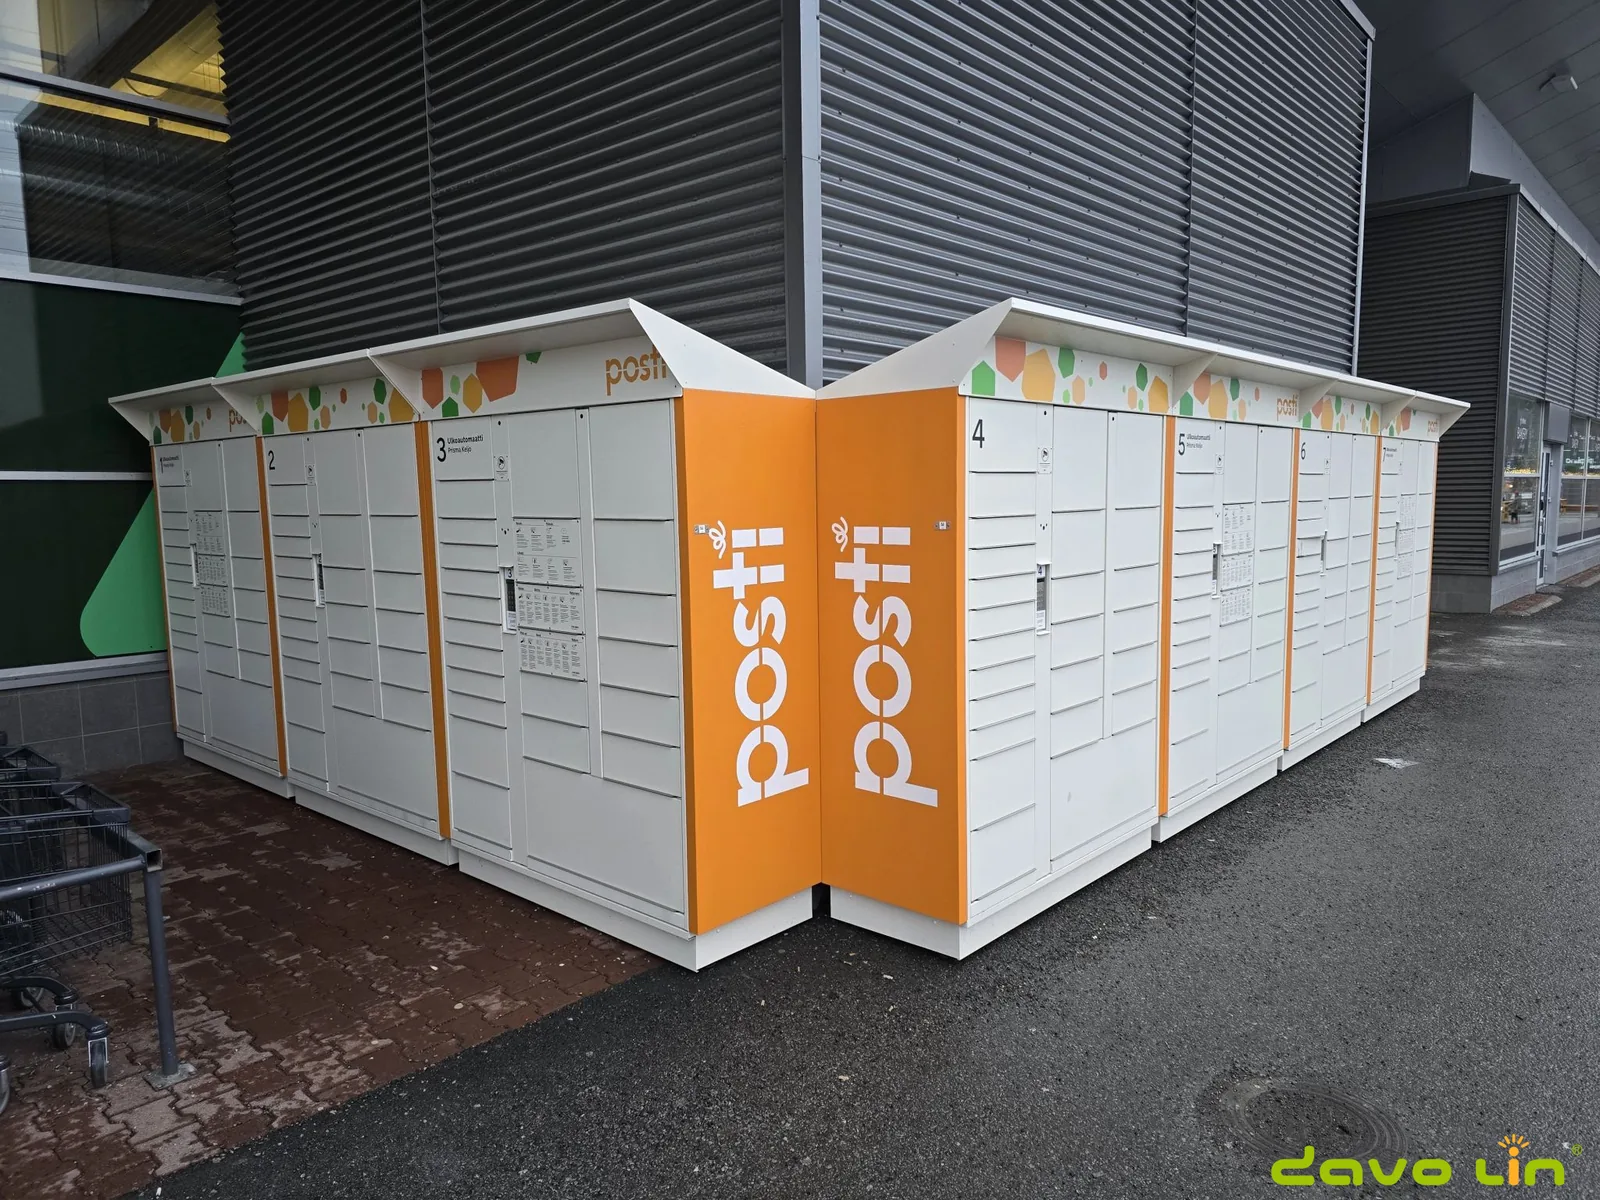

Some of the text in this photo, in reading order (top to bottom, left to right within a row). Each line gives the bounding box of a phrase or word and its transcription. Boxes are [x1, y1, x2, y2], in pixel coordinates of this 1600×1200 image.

[1276, 393, 1298, 422] posti
[447, 434, 484, 445] Ulkoautomaatti
[972, 419, 985, 449] 4
[436, 437, 447, 462] 3
[1178, 433, 1186, 456] 5
[1301, 442, 1306, 460] 6
[1382, 447, 1387, 462] 7
[160, 457, 164, 474] 1
[268, 450, 275, 470] 2
[507, 568, 513, 578] 3
[1038, 565, 1042, 575] 4
[713, 527, 809, 808] posti
[834, 525, 938, 808] posti
